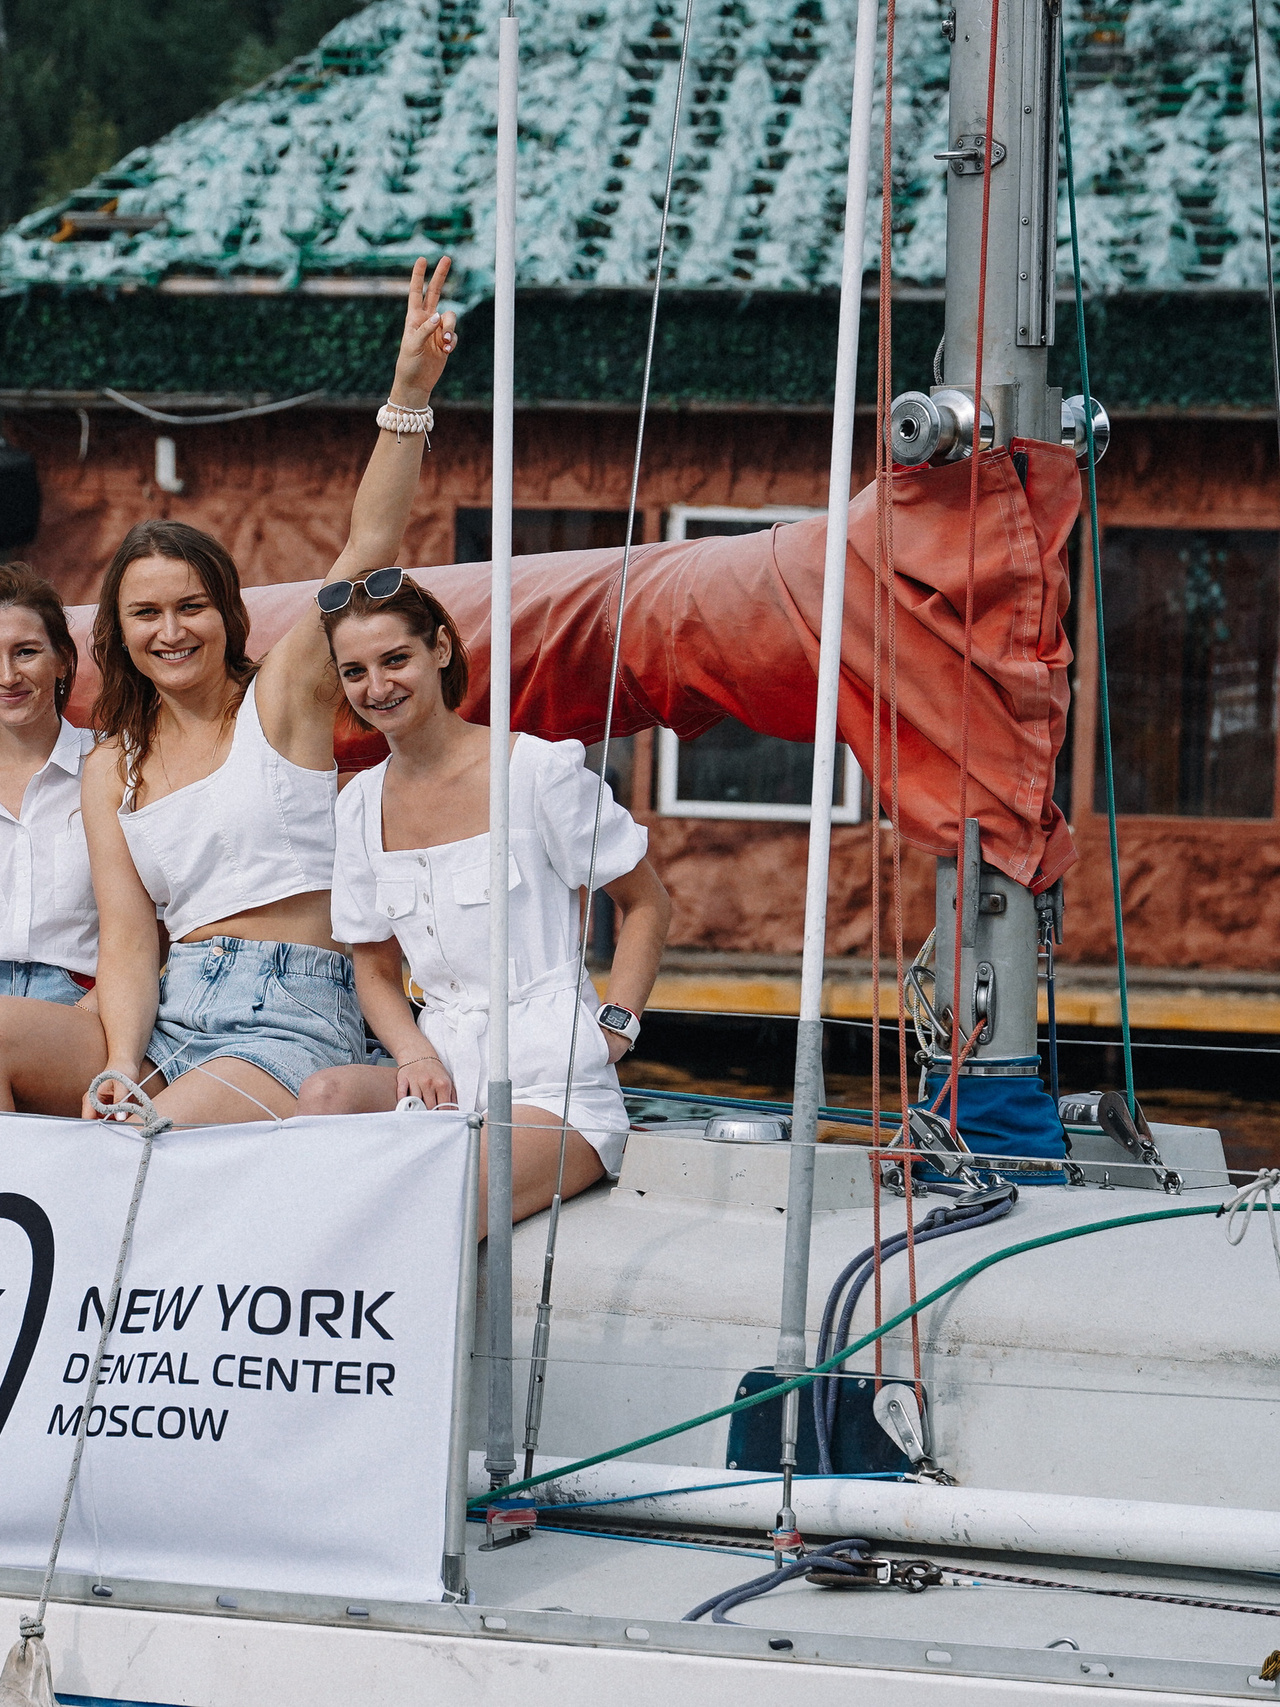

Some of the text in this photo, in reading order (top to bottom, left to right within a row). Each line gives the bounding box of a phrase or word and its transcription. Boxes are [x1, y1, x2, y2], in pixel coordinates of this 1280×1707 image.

[78, 1284, 395, 1341] NEW YORK
[63, 1352, 395, 1396] DENTAL CENTER
[47, 1404, 229, 1442] MOSCOW
